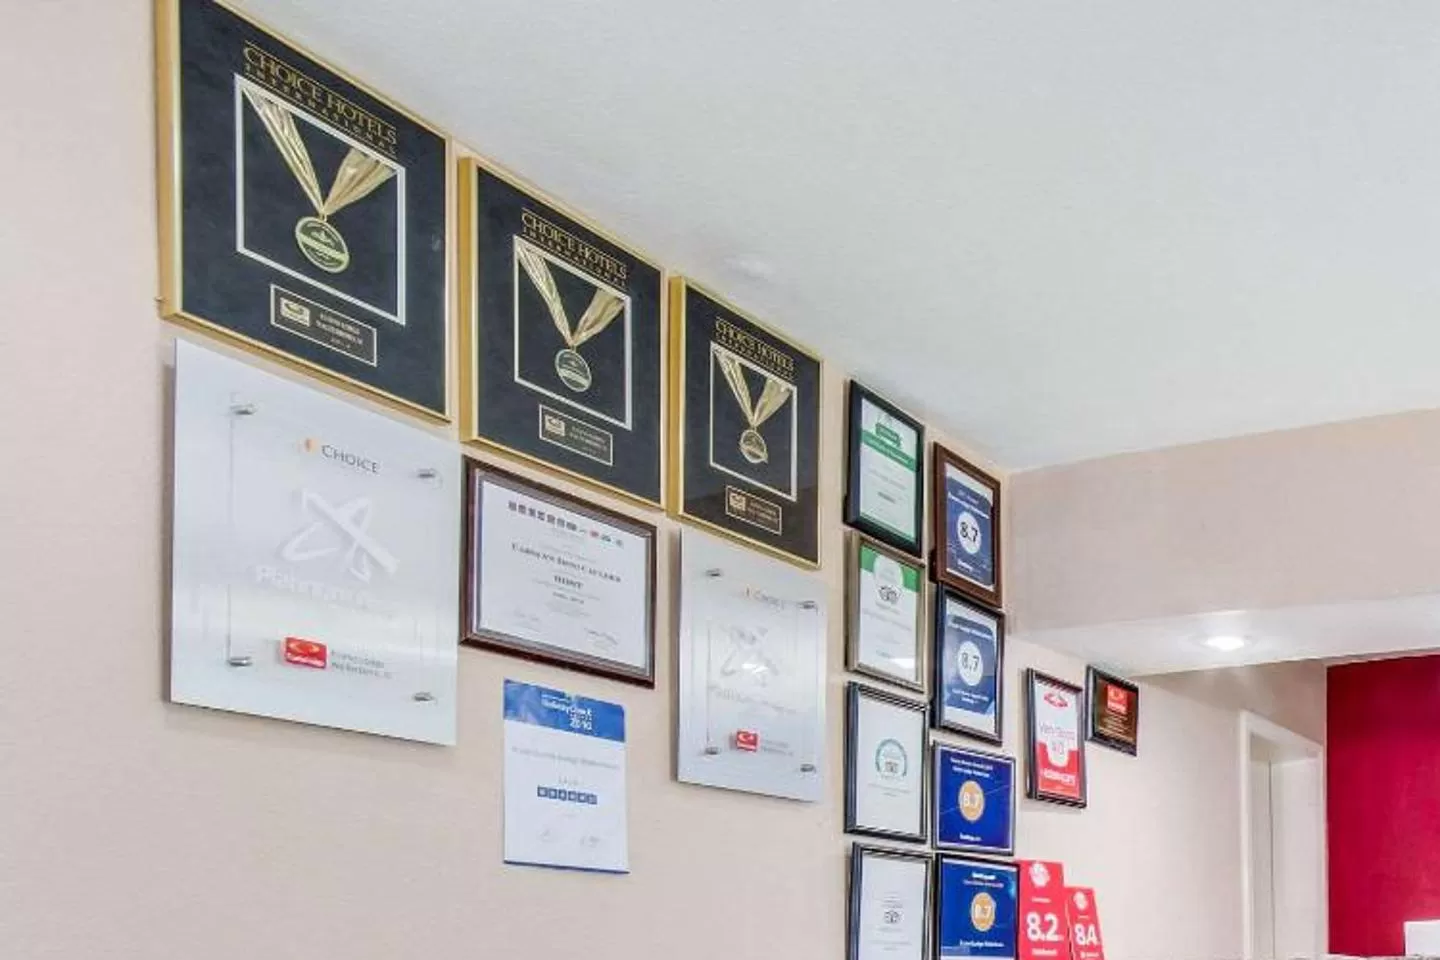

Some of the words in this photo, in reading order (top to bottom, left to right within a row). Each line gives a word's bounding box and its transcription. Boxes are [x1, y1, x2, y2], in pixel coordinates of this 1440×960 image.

[243, 47, 323, 99] CHOICE
[327, 92, 397, 145] HOTELS
[522, 213, 576, 252] CHOICE
[321, 444, 378, 473] CHOICE
[960, 521, 978, 543] 8.7
[1026, 911, 1059, 942] 8.2
